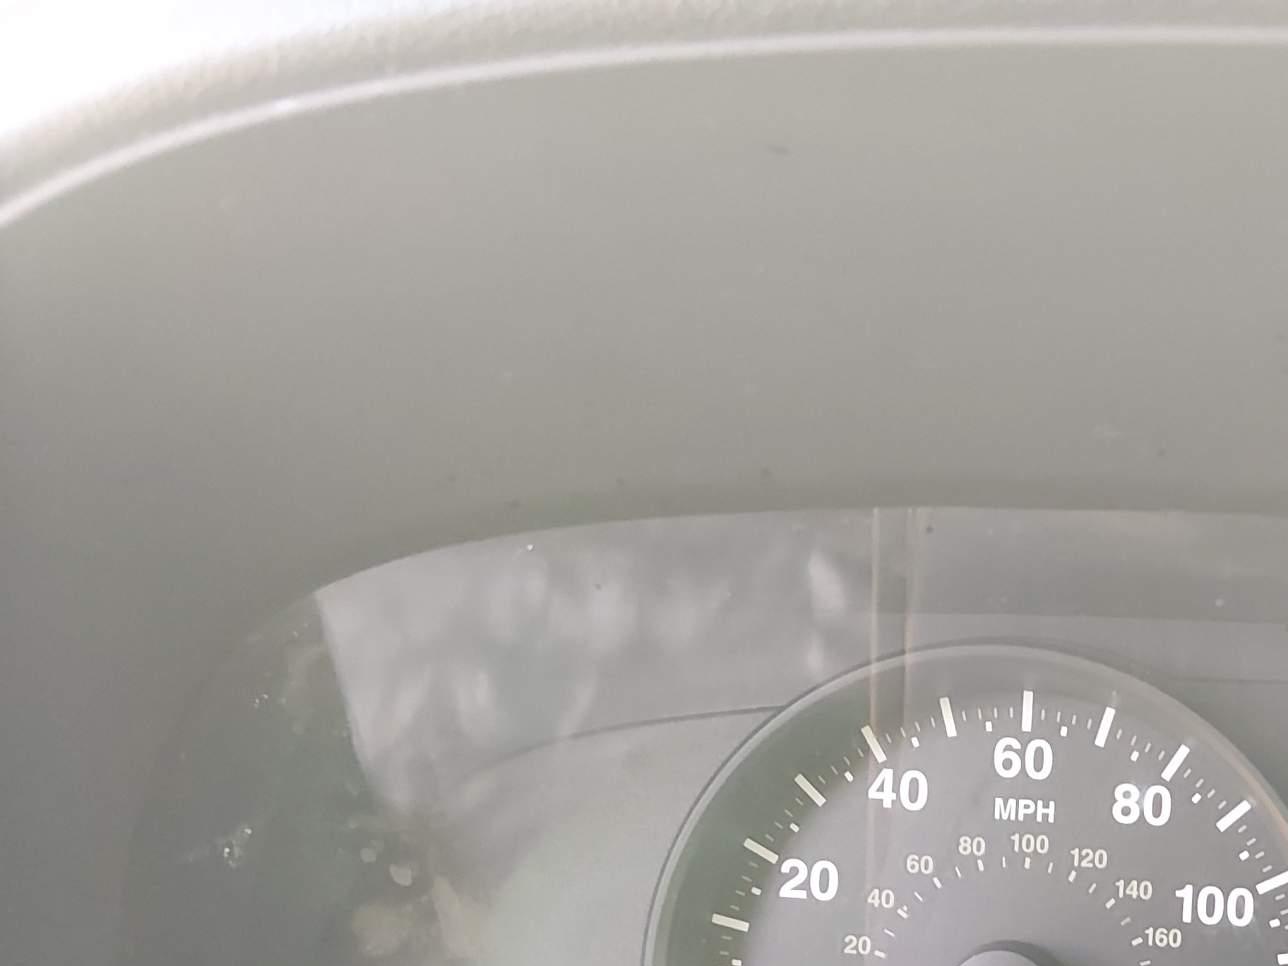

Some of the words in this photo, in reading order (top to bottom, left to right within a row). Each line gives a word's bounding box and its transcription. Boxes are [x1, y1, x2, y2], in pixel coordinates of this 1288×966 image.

[993, 737, 1053, 780] 60
[868, 768, 928, 811] 40
[993, 797, 1056, 823] MPH
[1112, 783, 1172, 826] 80
[958, 835, 985, 856] 80
[1010, 833, 1049, 854] 100
[906, 854, 934, 875] 60
[1070, 848, 1108, 869] 120
[778, 858, 839, 901] 20
[1115, 879, 1153, 900] 140
[867, 889, 895, 909] 40
[1174, 885, 1254, 927] 100
[843, 935, 872, 956] 20
[1144, 927, 1182, 948] 160
